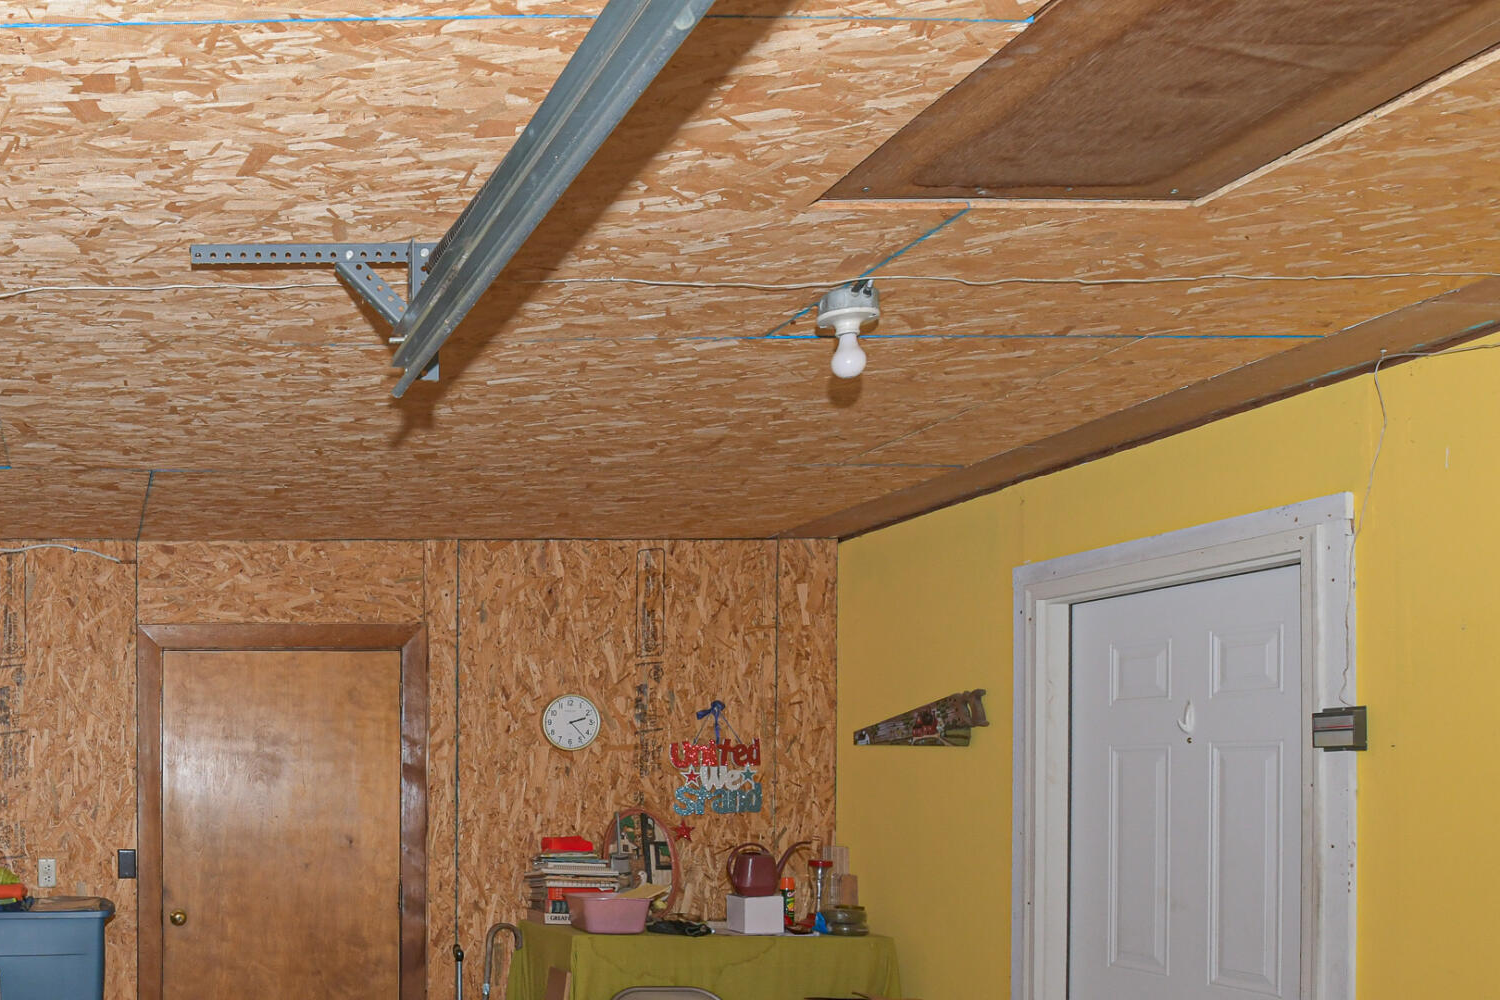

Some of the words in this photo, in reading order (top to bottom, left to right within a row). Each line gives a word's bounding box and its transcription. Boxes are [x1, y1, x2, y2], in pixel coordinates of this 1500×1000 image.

[669, 738, 761, 769] United
[699, 765, 741, 791] We
[673, 782, 762, 816] Stand
